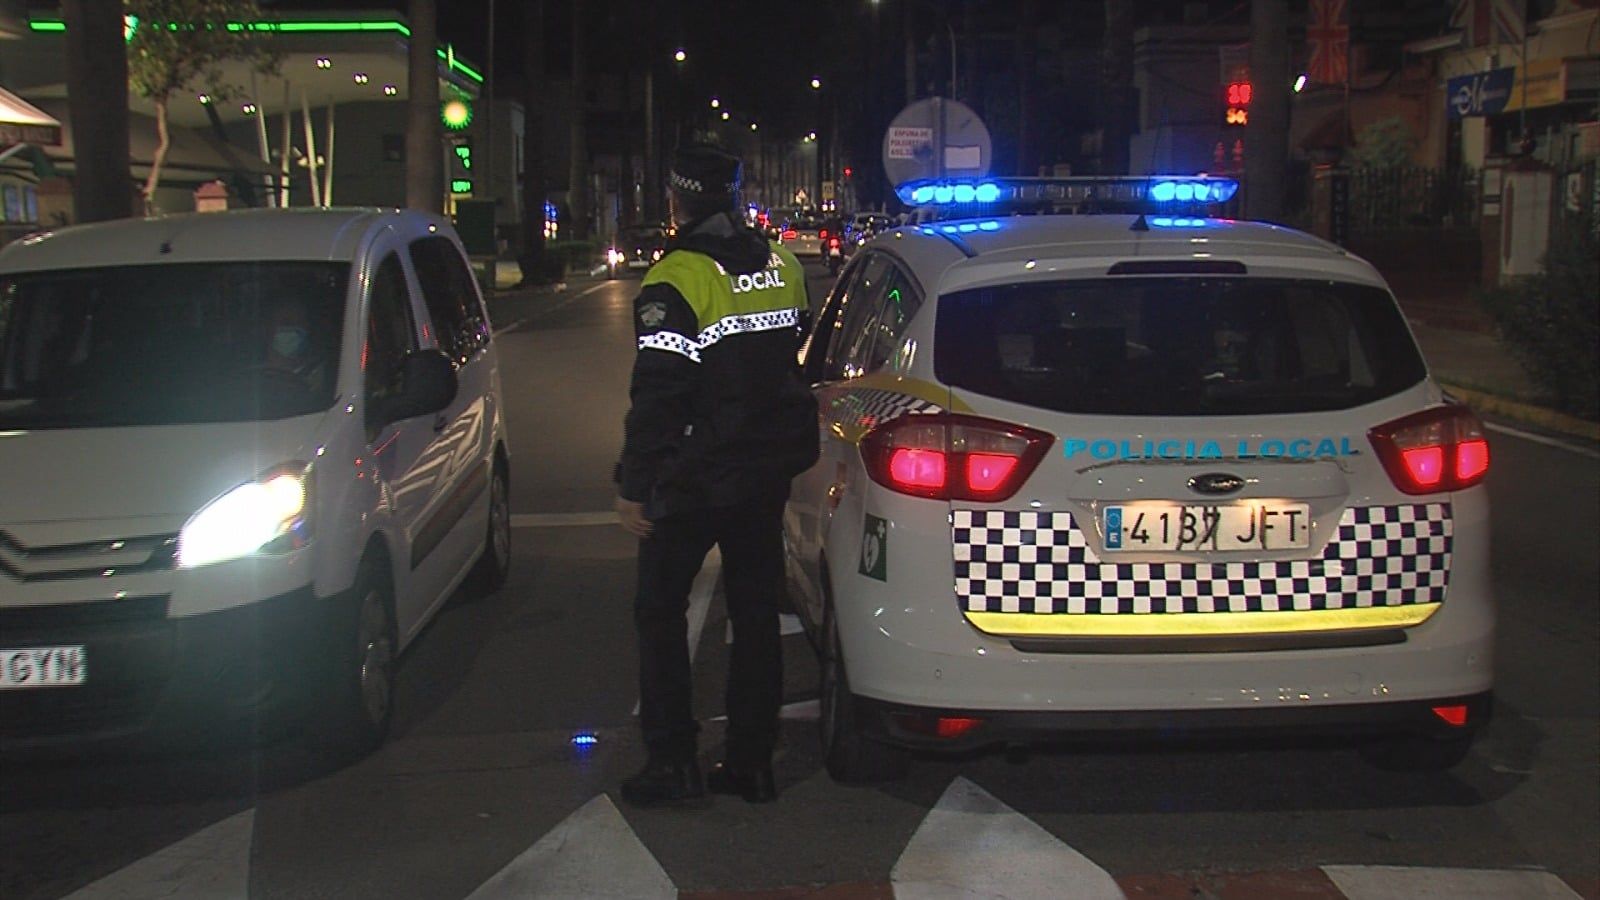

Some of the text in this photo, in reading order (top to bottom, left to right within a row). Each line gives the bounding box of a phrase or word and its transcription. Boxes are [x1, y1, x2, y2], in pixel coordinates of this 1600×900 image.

[730, 269, 785, 294] LOCAL
[1063, 437, 1358, 460] POLICIA LOCAL
[1108, 532, 1119, 543] E
[1236, 508, 1302, 543] JFT
